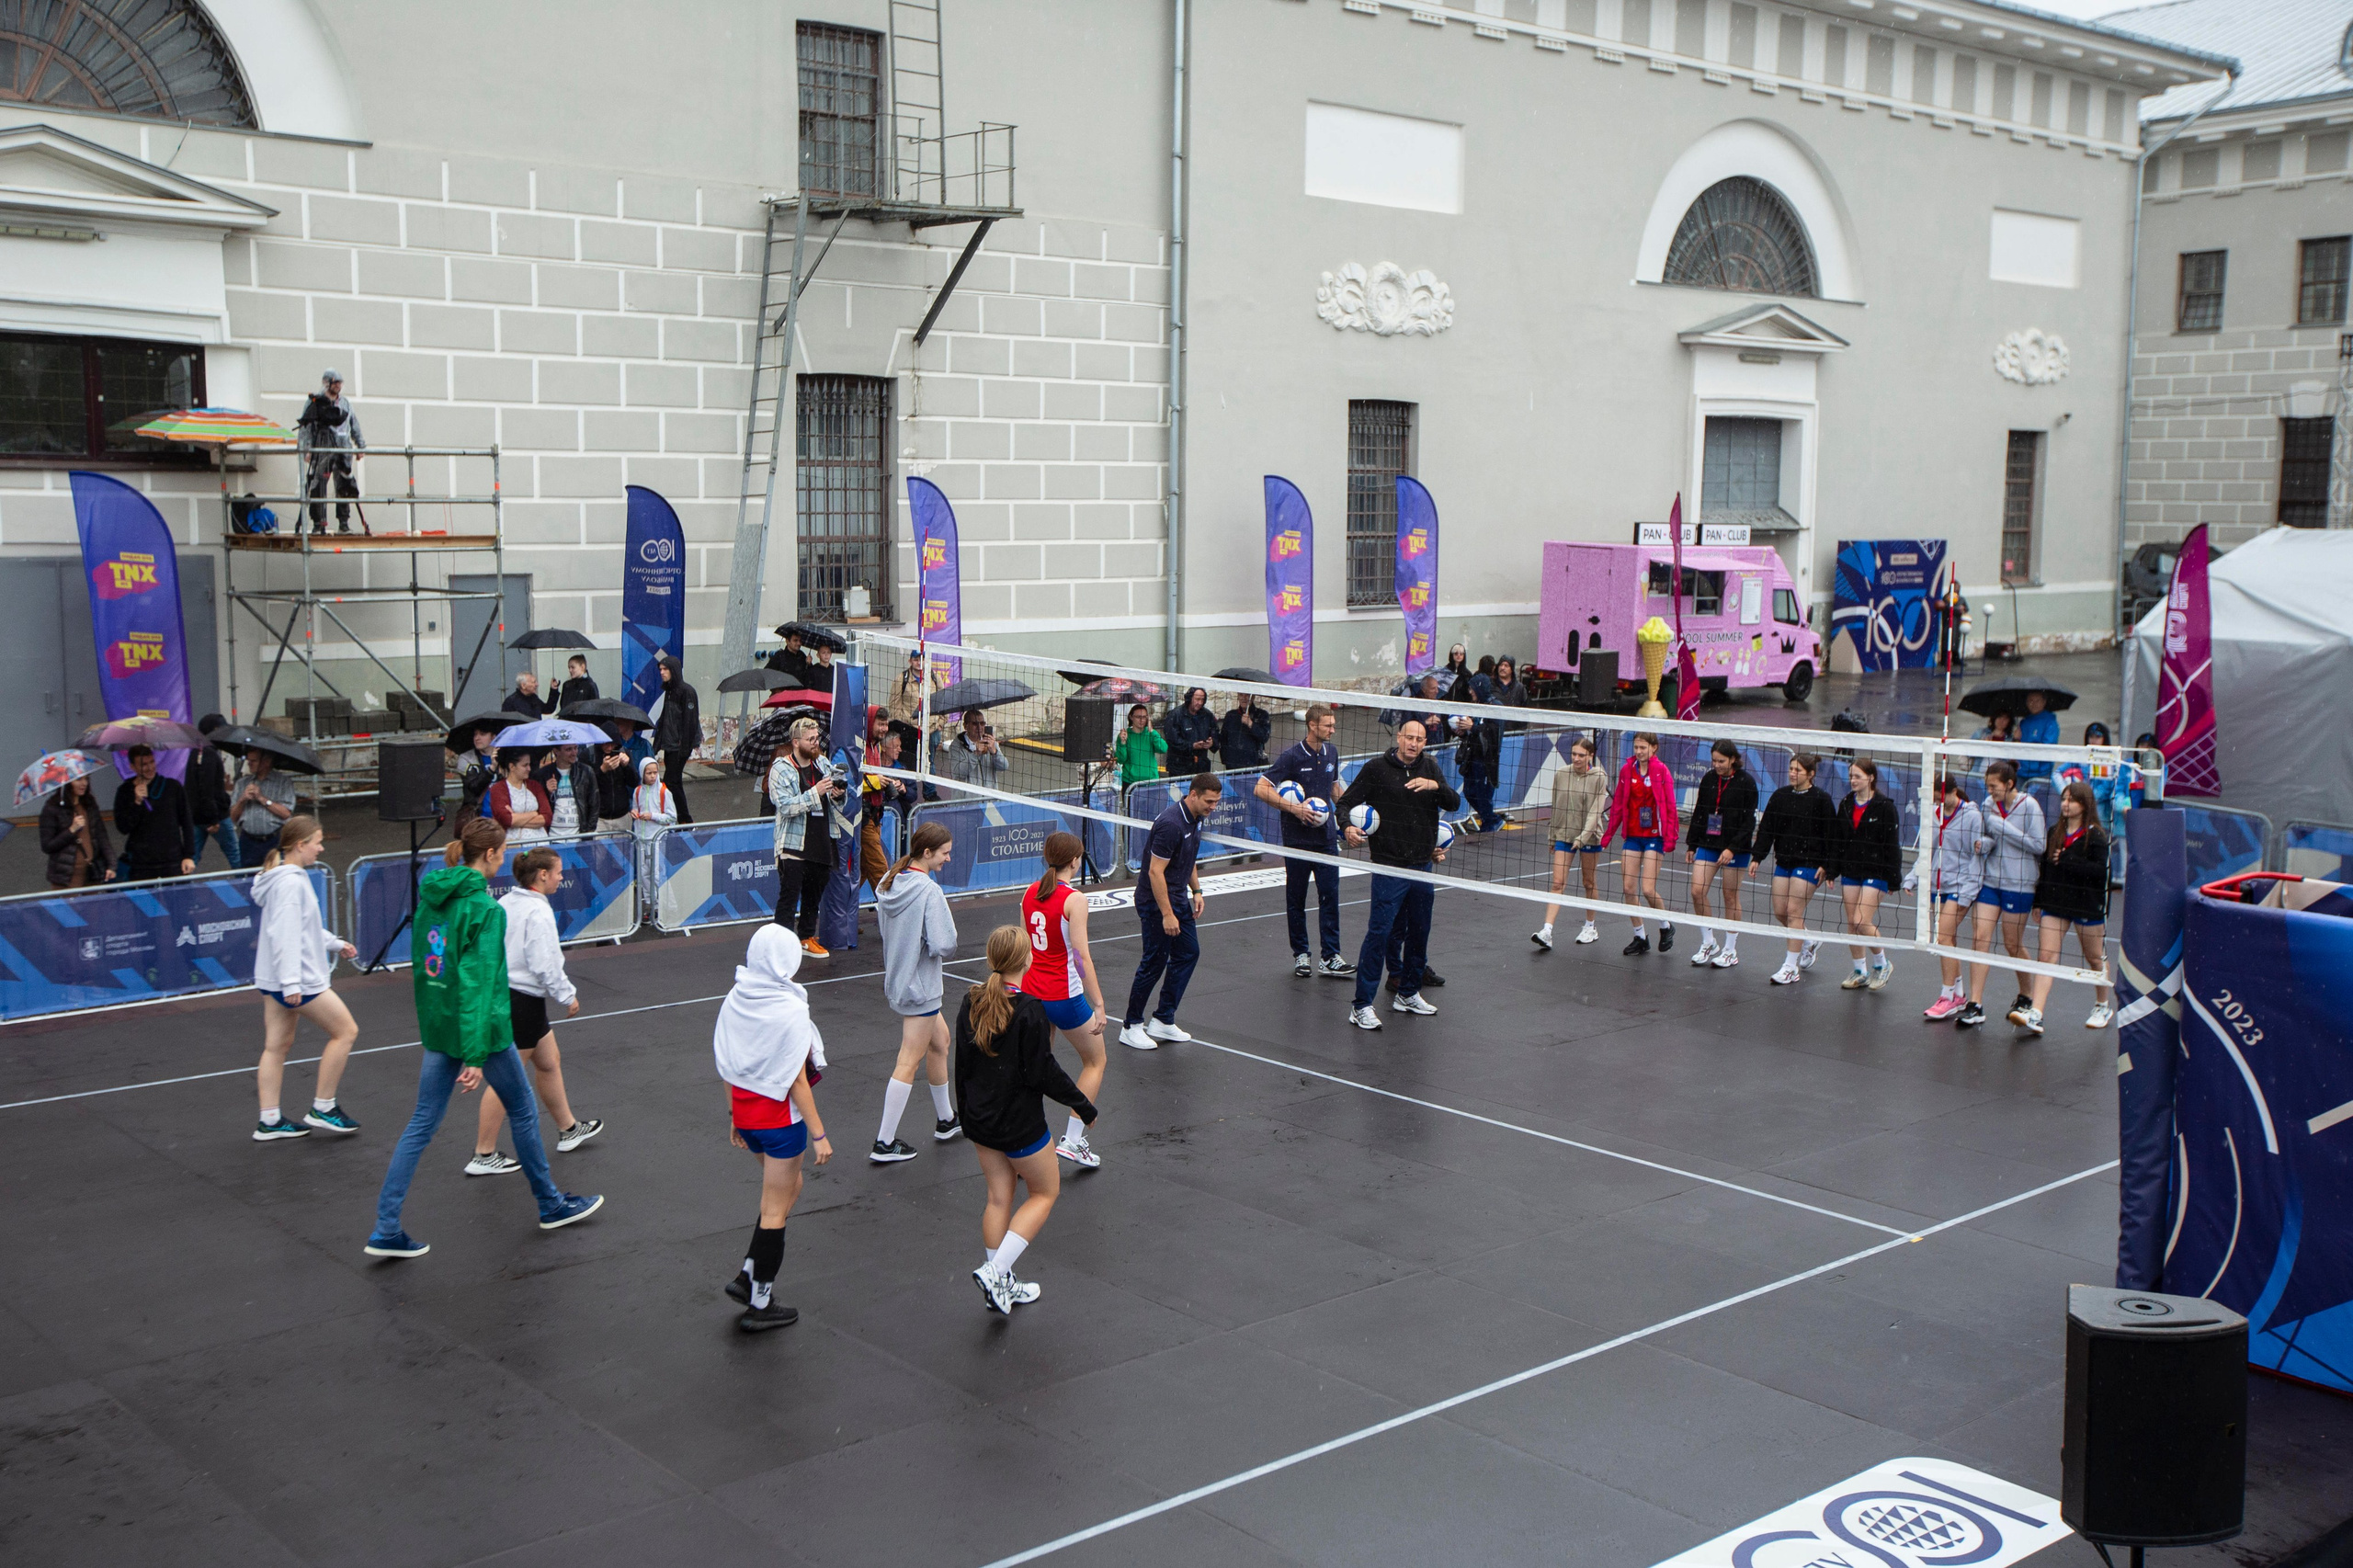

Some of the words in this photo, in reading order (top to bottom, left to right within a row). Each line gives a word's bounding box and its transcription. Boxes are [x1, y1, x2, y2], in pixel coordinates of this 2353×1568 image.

[1643, 528, 1662, 540] PAN
[1706, 529, 1722, 540] PAN
[1727, 530, 1747, 541] CLUB
[1278, 536, 1301, 551] TNX
[1408, 535, 1427, 550] TNX
[108, 562, 158, 584] TNX
[1682, 633, 1702, 643] OOL
[1706, 632, 1744, 643] SUMMER
[119, 642, 165, 661] TNX
[1285, 646, 1303, 661] TNX
[1203, 814, 1244, 827] 0.volley.ru
[992, 835, 1006, 844] 1923
[1030, 831, 1045, 839] 2023
[991, 841, 1044, 857] СТОЛЕТИЕ
[727, 860, 754, 881] 100
[1030, 911, 1048, 951] 3
[2211, 988, 2264, 1046] 2023
